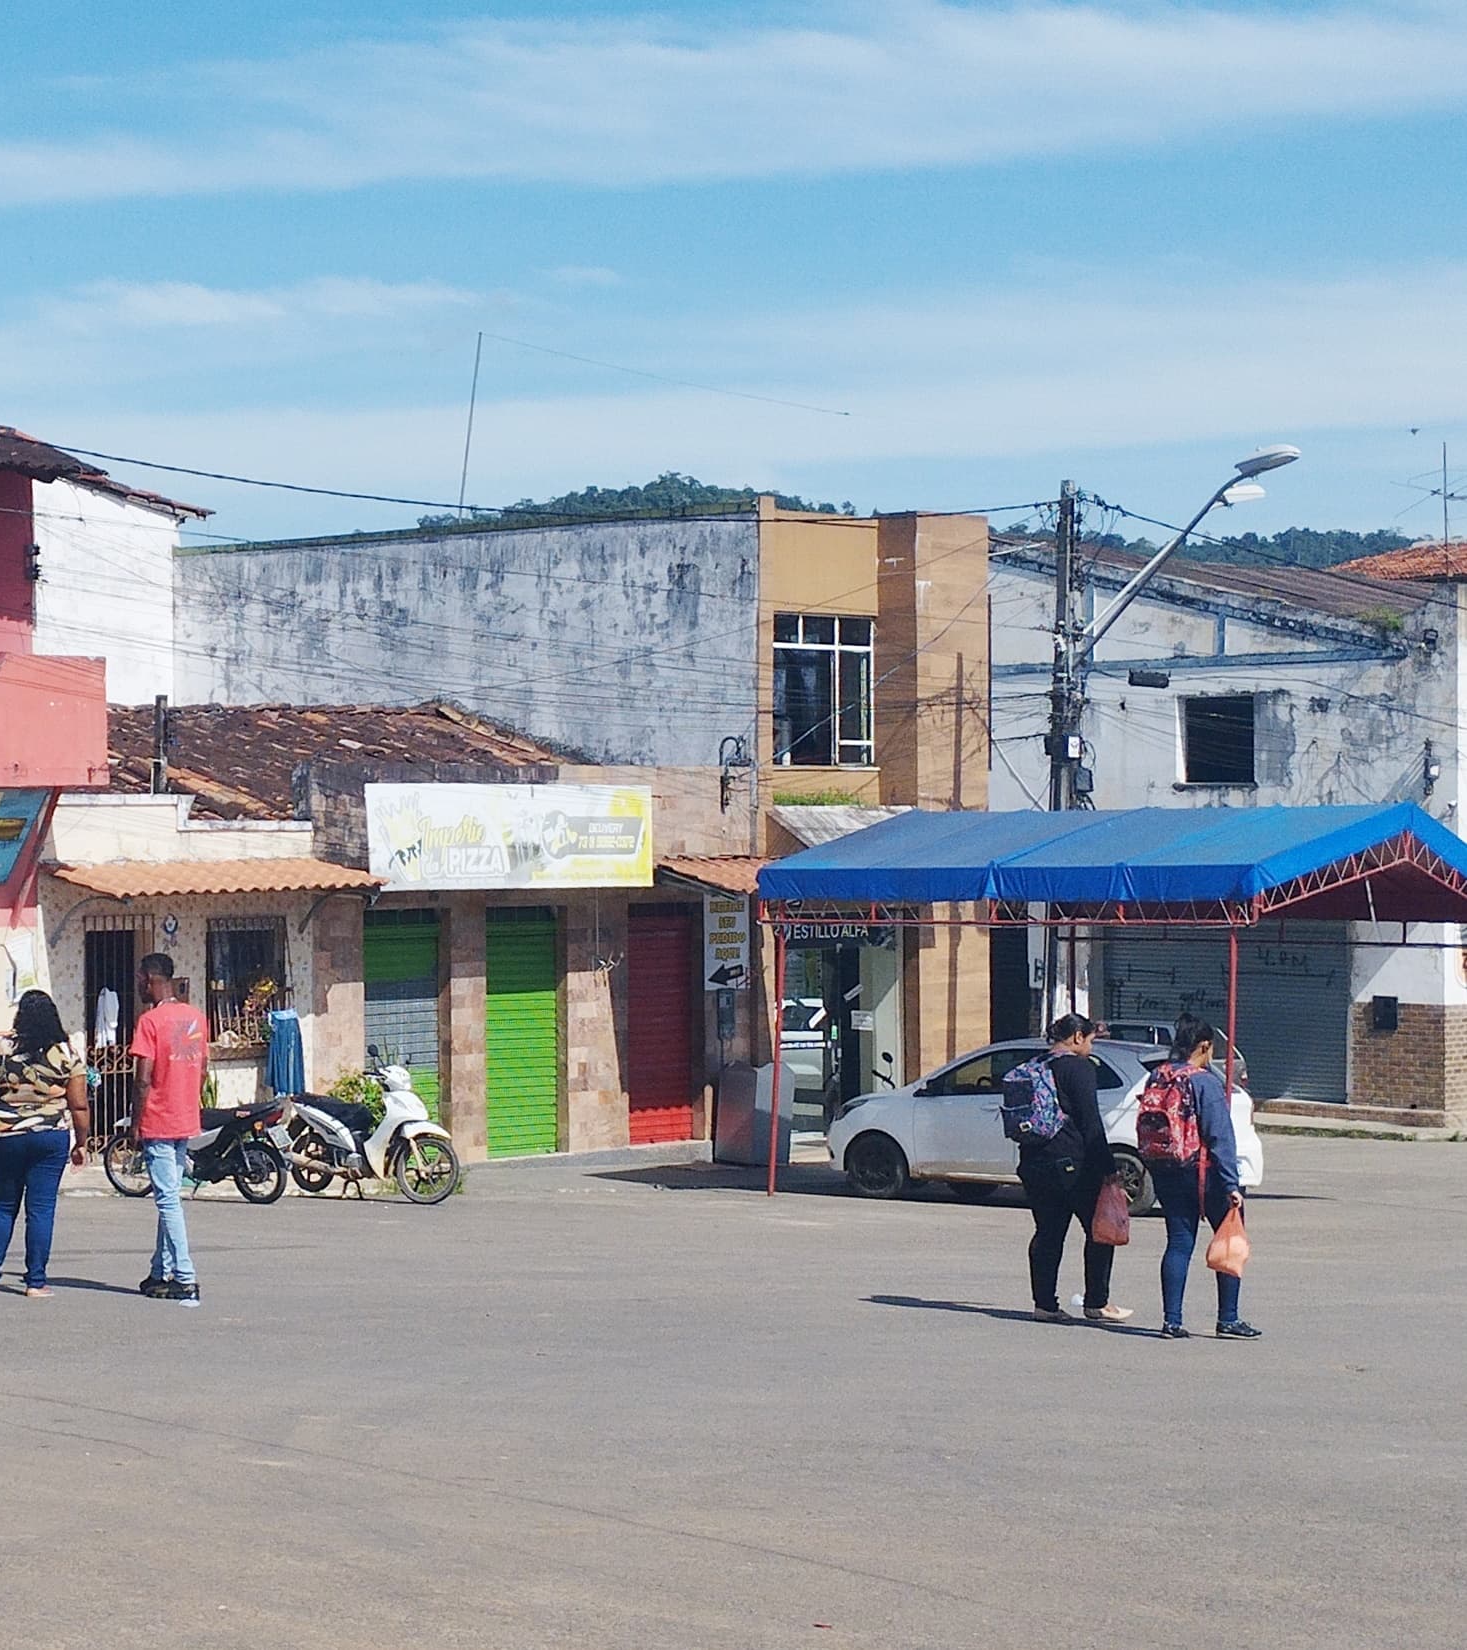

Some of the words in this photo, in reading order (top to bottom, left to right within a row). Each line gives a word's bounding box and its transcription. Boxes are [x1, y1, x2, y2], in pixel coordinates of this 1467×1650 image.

[447, 846, 504, 874] PIZZA
[794, 924, 840, 939] ESTILLO
[841, 924, 869, 938] ALFA
